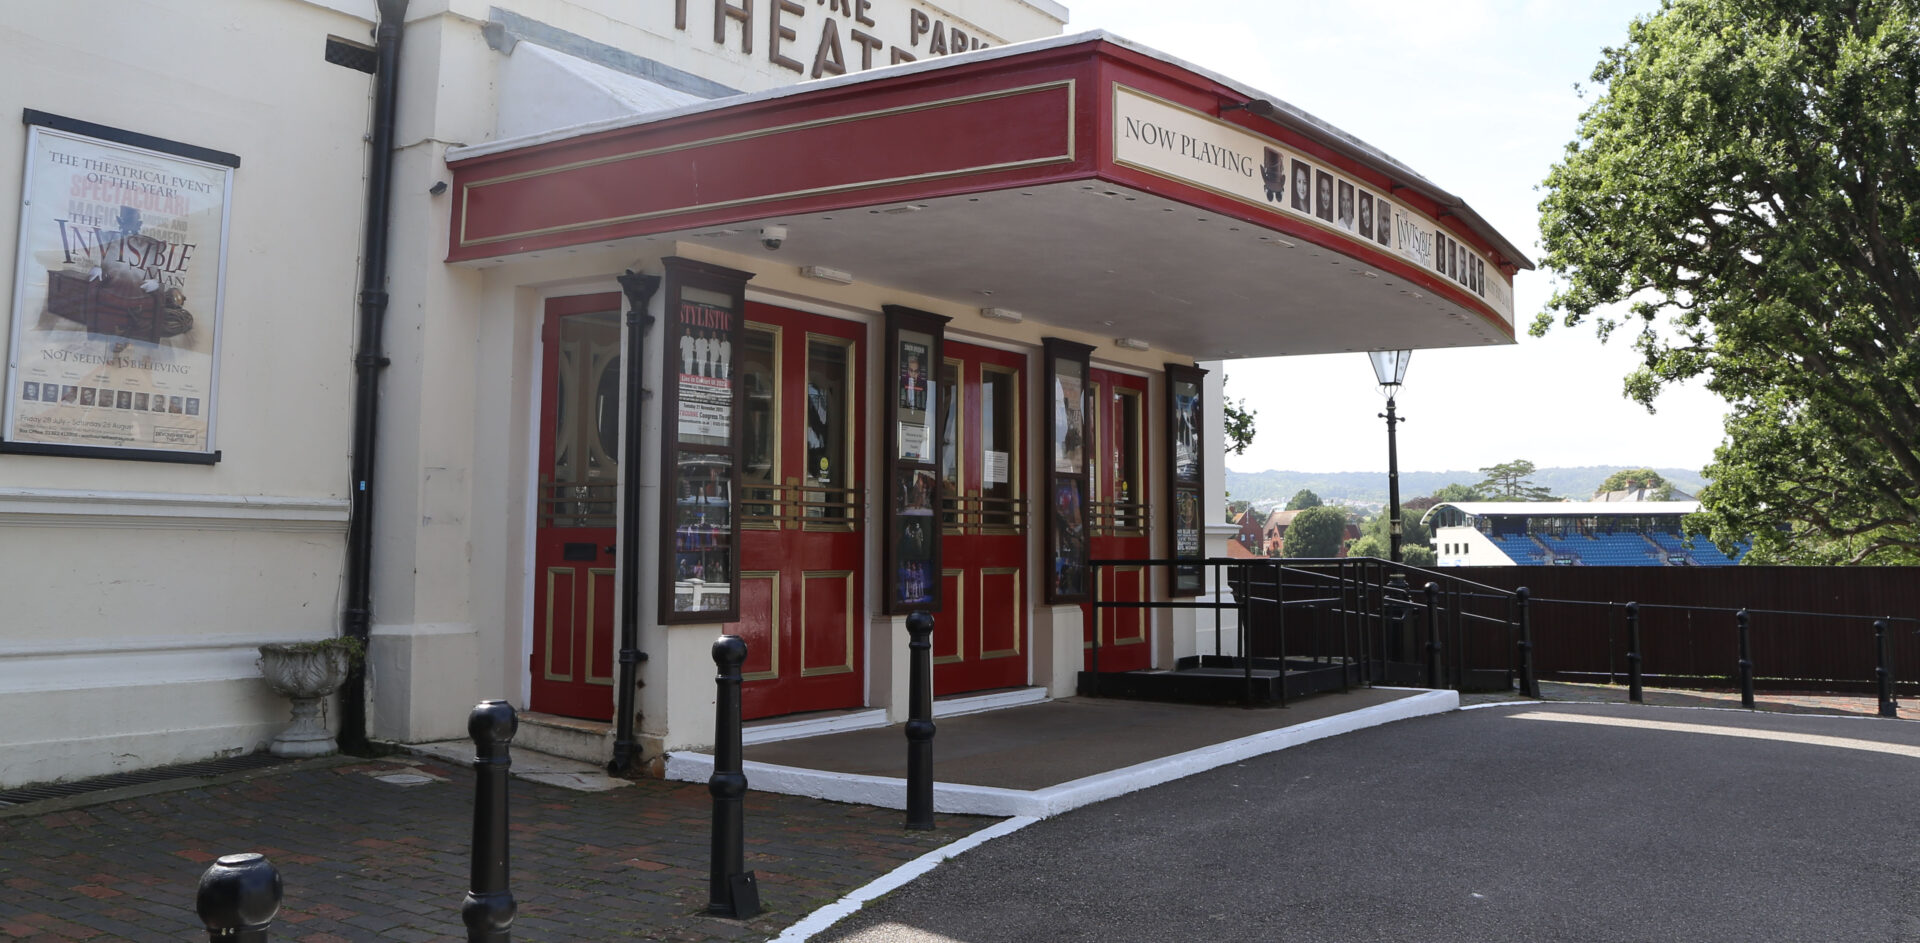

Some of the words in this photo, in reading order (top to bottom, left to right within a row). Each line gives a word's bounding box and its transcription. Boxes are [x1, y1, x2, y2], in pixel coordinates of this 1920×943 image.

[1125, 116, 1176, 151] NOW
[1181, 134, 1253, 178] PLAYING
[49, 150, 79, 167] THE
[82, 158, 168, 185] THEATRICAL
[171, 176, 212, 194] EVENT
[87, 172, 106, 185] OF
[109, 176, 137, 191] THE
[141, 183, 177, 199] YEAR!
[70, 174, 190, 217] SPECTACULAR!
[70, 212, 102, 228] THE
[1395, 213, 1432, 257] INVISIBLE
[54, 219, 197, 274] INVISIBLE
[142, 266, 186, 287] MAN
[73, 352, 113, 366] SEEING
